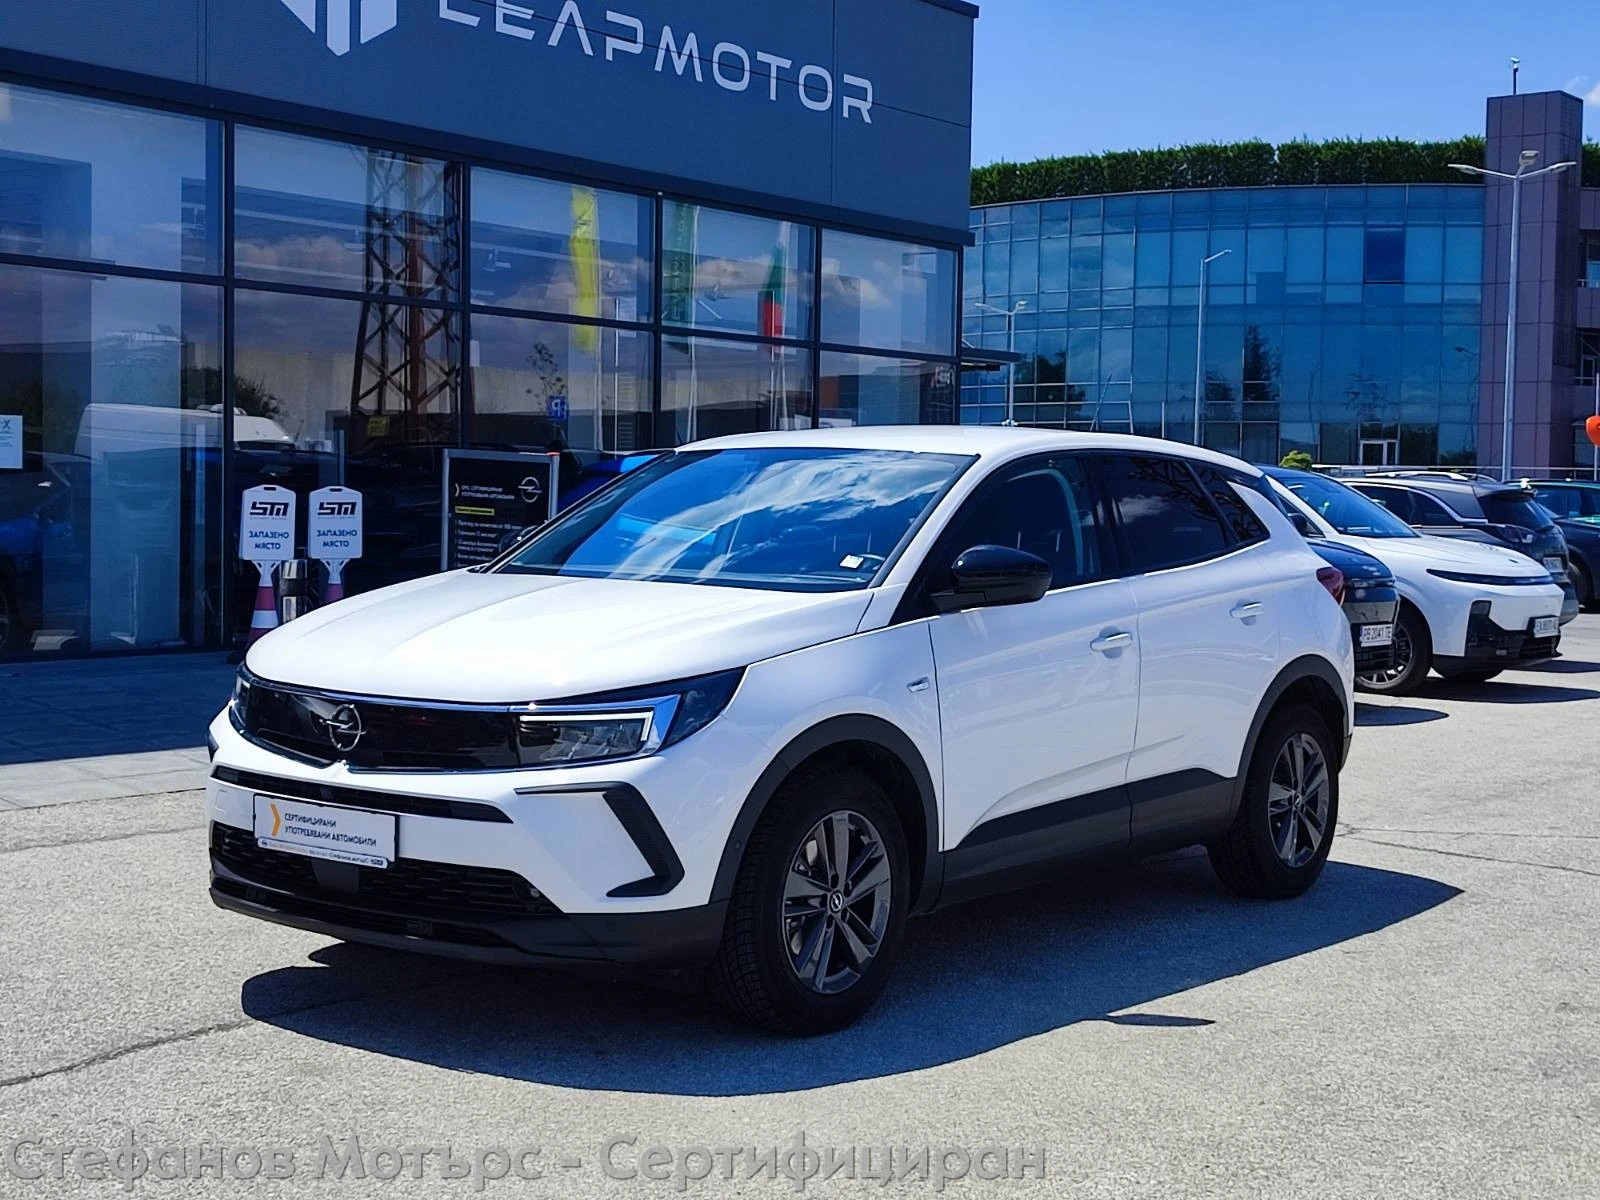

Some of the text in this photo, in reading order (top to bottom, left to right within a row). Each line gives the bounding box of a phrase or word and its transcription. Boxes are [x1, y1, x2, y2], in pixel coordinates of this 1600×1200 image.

[439, 0, 874, 125] LEAPMOTOR
[248, 530, 290, 540] ЗАПАЗЕНО
[316, 529, 358, 538] ЗАПАЗЕНО
[254, 542, 281, 550] МЯСТО
[322, 540, 350, 548] МЯСТО
[284, 812, 337, 828] СЕРТИФИЦИРАНИ
[332, 834, 378, 847] АВТОМОБИЛИ
